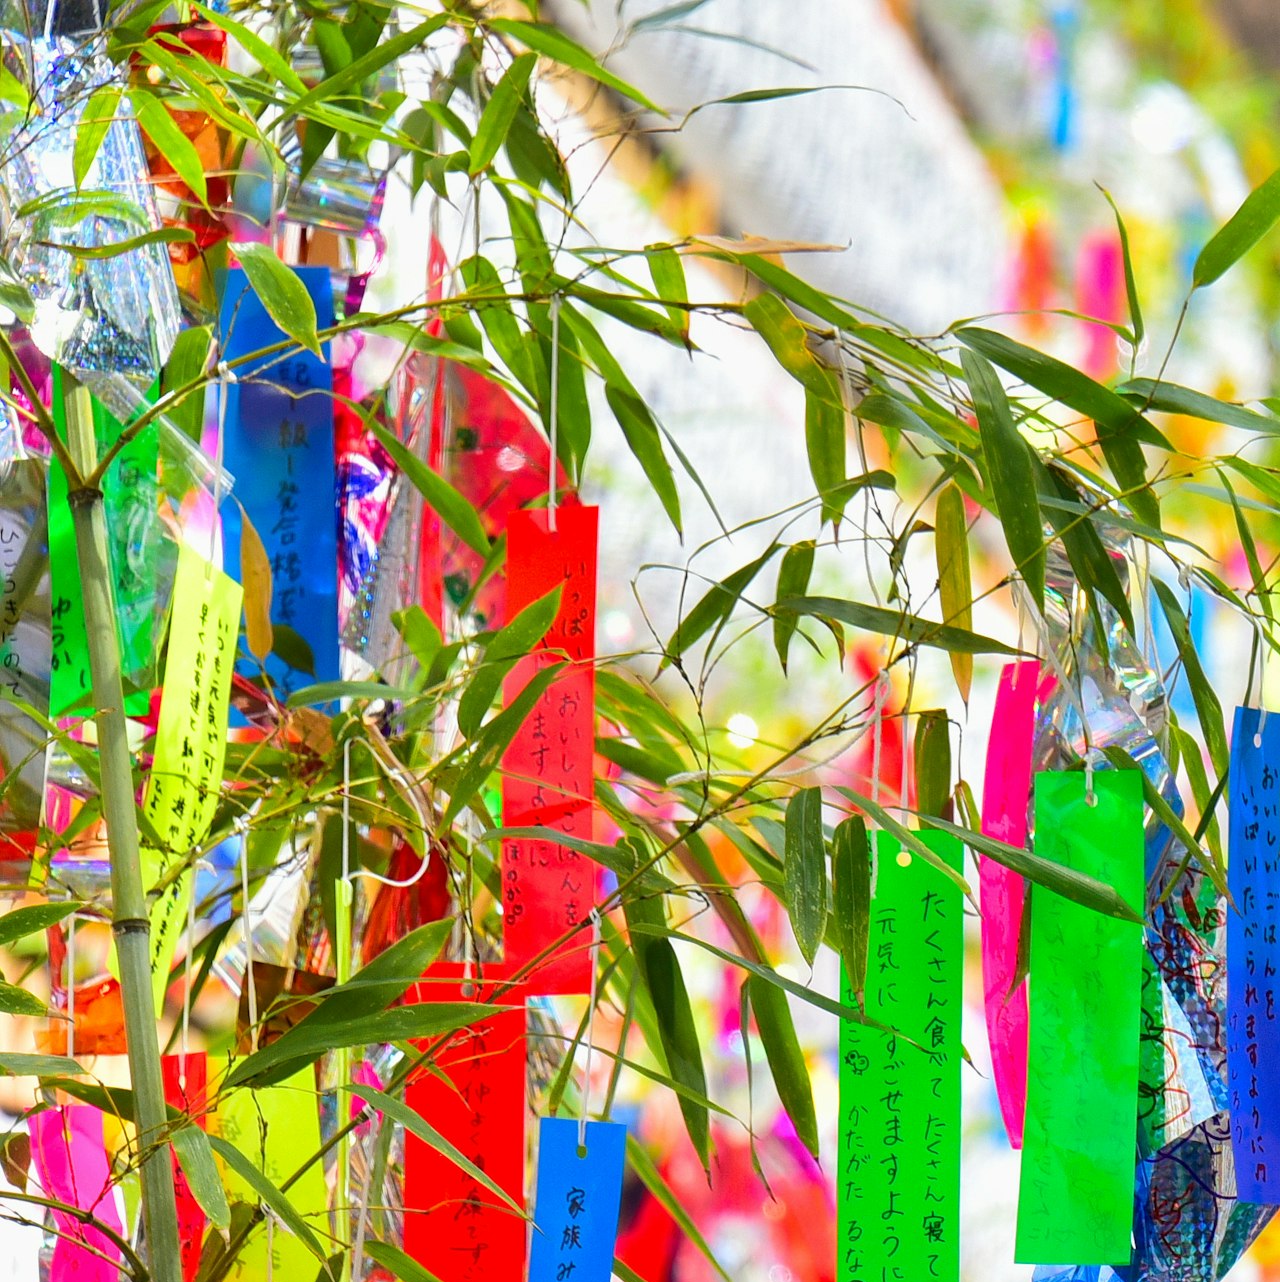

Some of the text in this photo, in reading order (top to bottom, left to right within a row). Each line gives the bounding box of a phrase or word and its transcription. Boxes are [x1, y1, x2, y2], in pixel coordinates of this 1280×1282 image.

[1239, 785, 1266, 1155] いっぱいたべられますように
[1262, 762, 1280, 1021] おいしいごはんを
